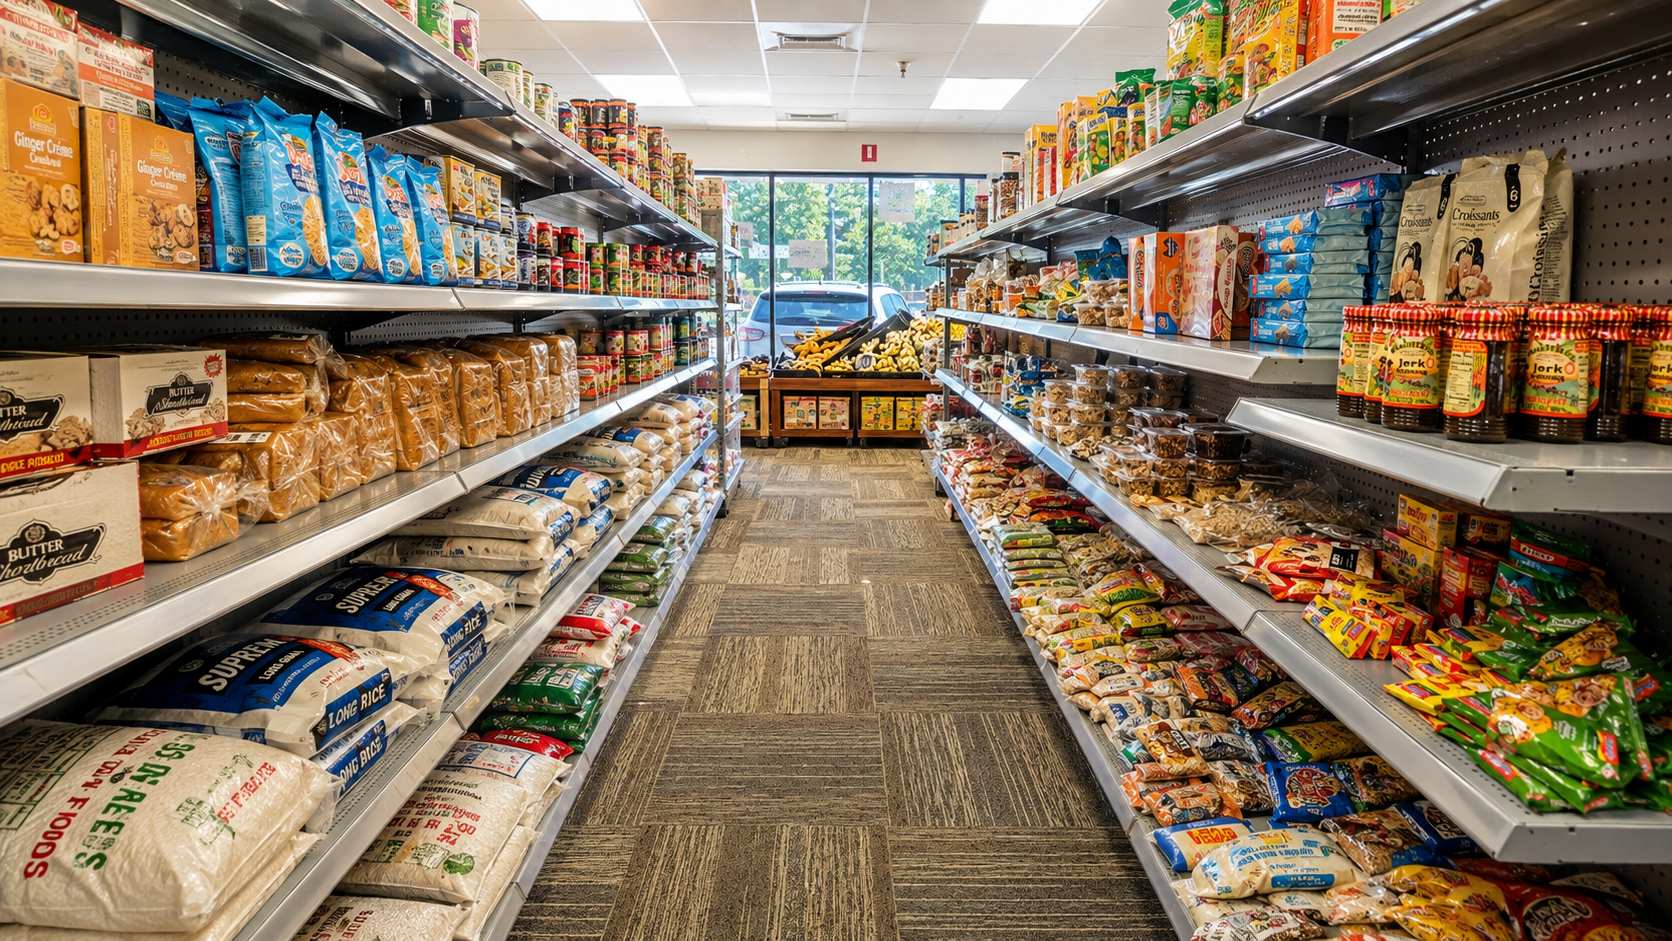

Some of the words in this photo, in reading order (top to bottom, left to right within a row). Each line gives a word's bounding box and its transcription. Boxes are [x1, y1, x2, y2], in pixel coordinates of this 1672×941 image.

[14, 130, 46, 152] Ginger
[1452, 207, 1501, 222] Croissants
[8, 538, 65, 563] BUTTER
[328, 699, 358, 729] LONG
[360, 683, 387, 712] RICE
